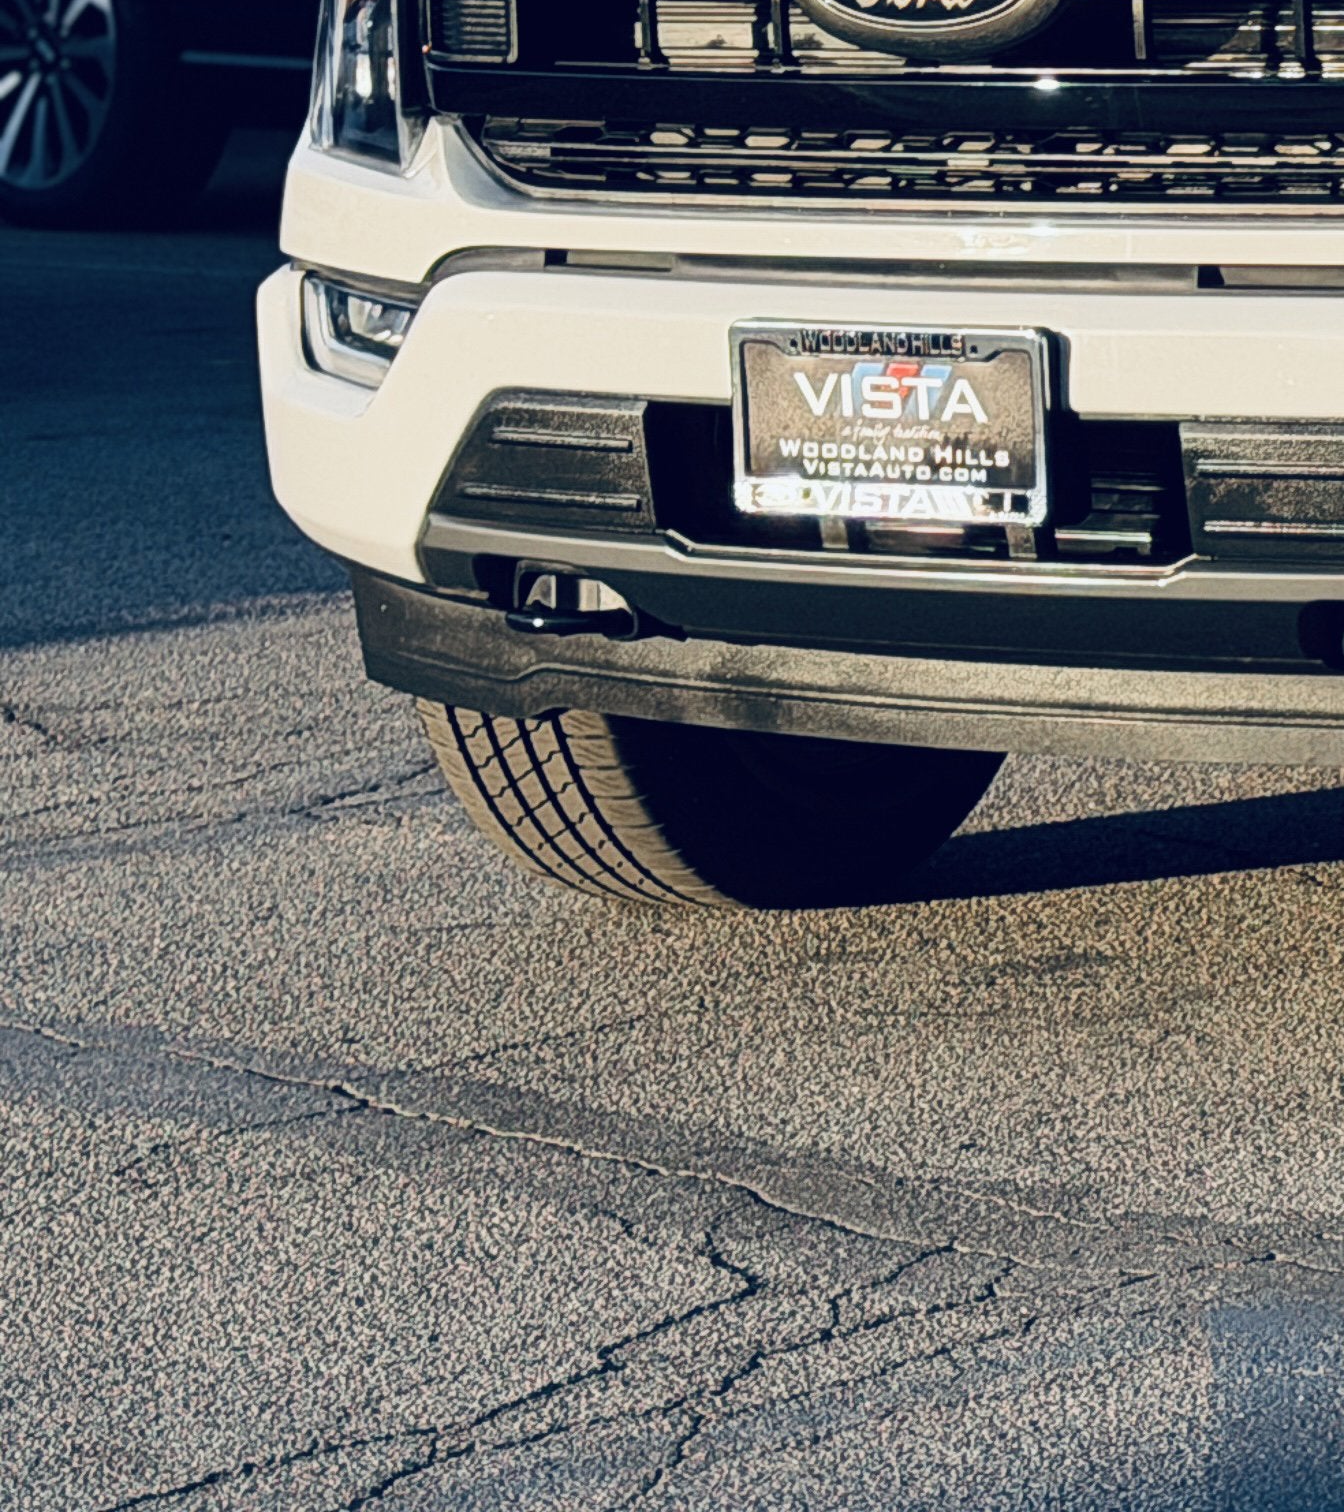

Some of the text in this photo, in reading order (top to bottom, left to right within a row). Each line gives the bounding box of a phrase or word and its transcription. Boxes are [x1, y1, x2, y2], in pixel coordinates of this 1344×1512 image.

[802, 329, 907, 354] WOODLAND
[794, 372, 989, 424] VISTA
[779, 439, 1011, 468] WOODLAND HILLS
[810, 484, 951, 516] VISTA
